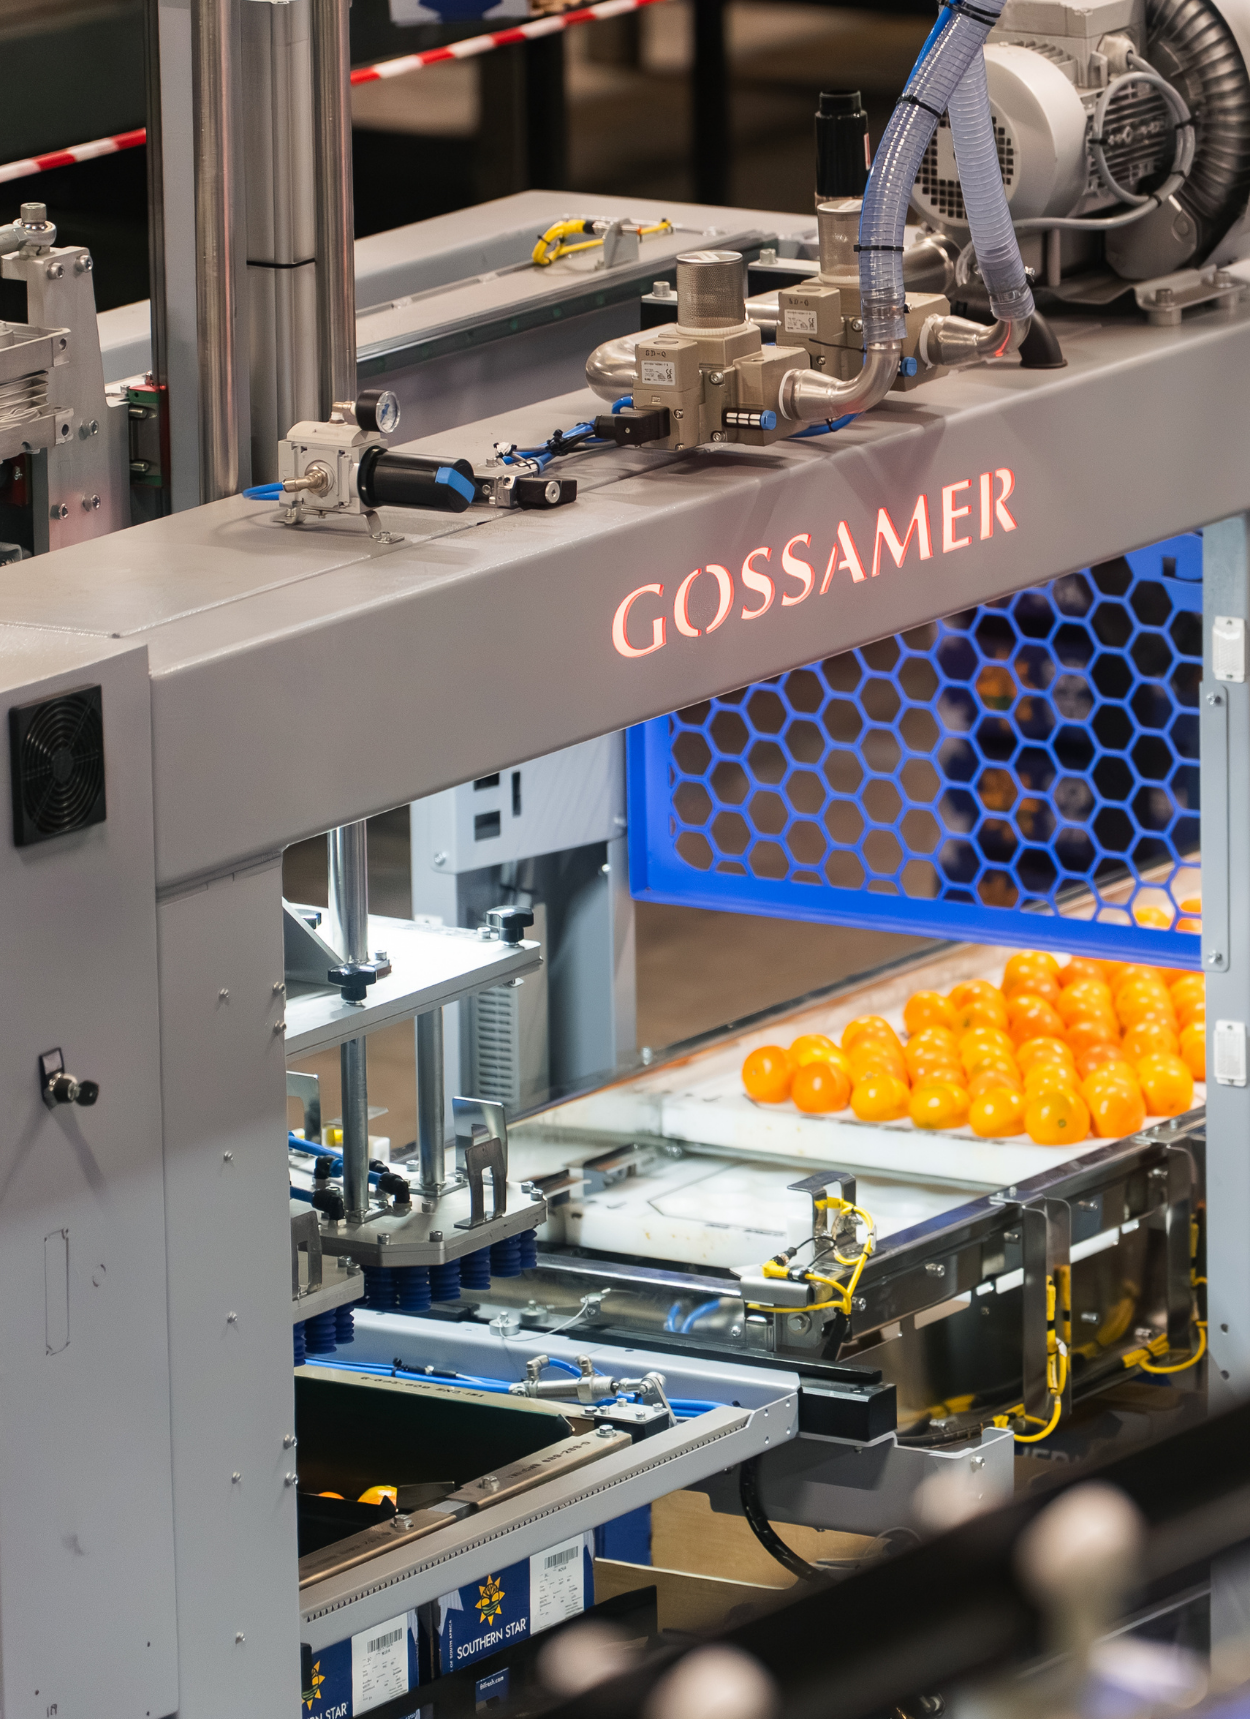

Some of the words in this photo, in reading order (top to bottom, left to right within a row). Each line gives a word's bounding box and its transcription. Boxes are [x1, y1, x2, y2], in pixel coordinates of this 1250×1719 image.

[611, 467, 1018, 658] GOSSAMER
[457, 1627, 503, 1659] SOUTHERN
[505, 1618, 526, 1638] STAR
[325, 1702, 347, 1719] STAR
